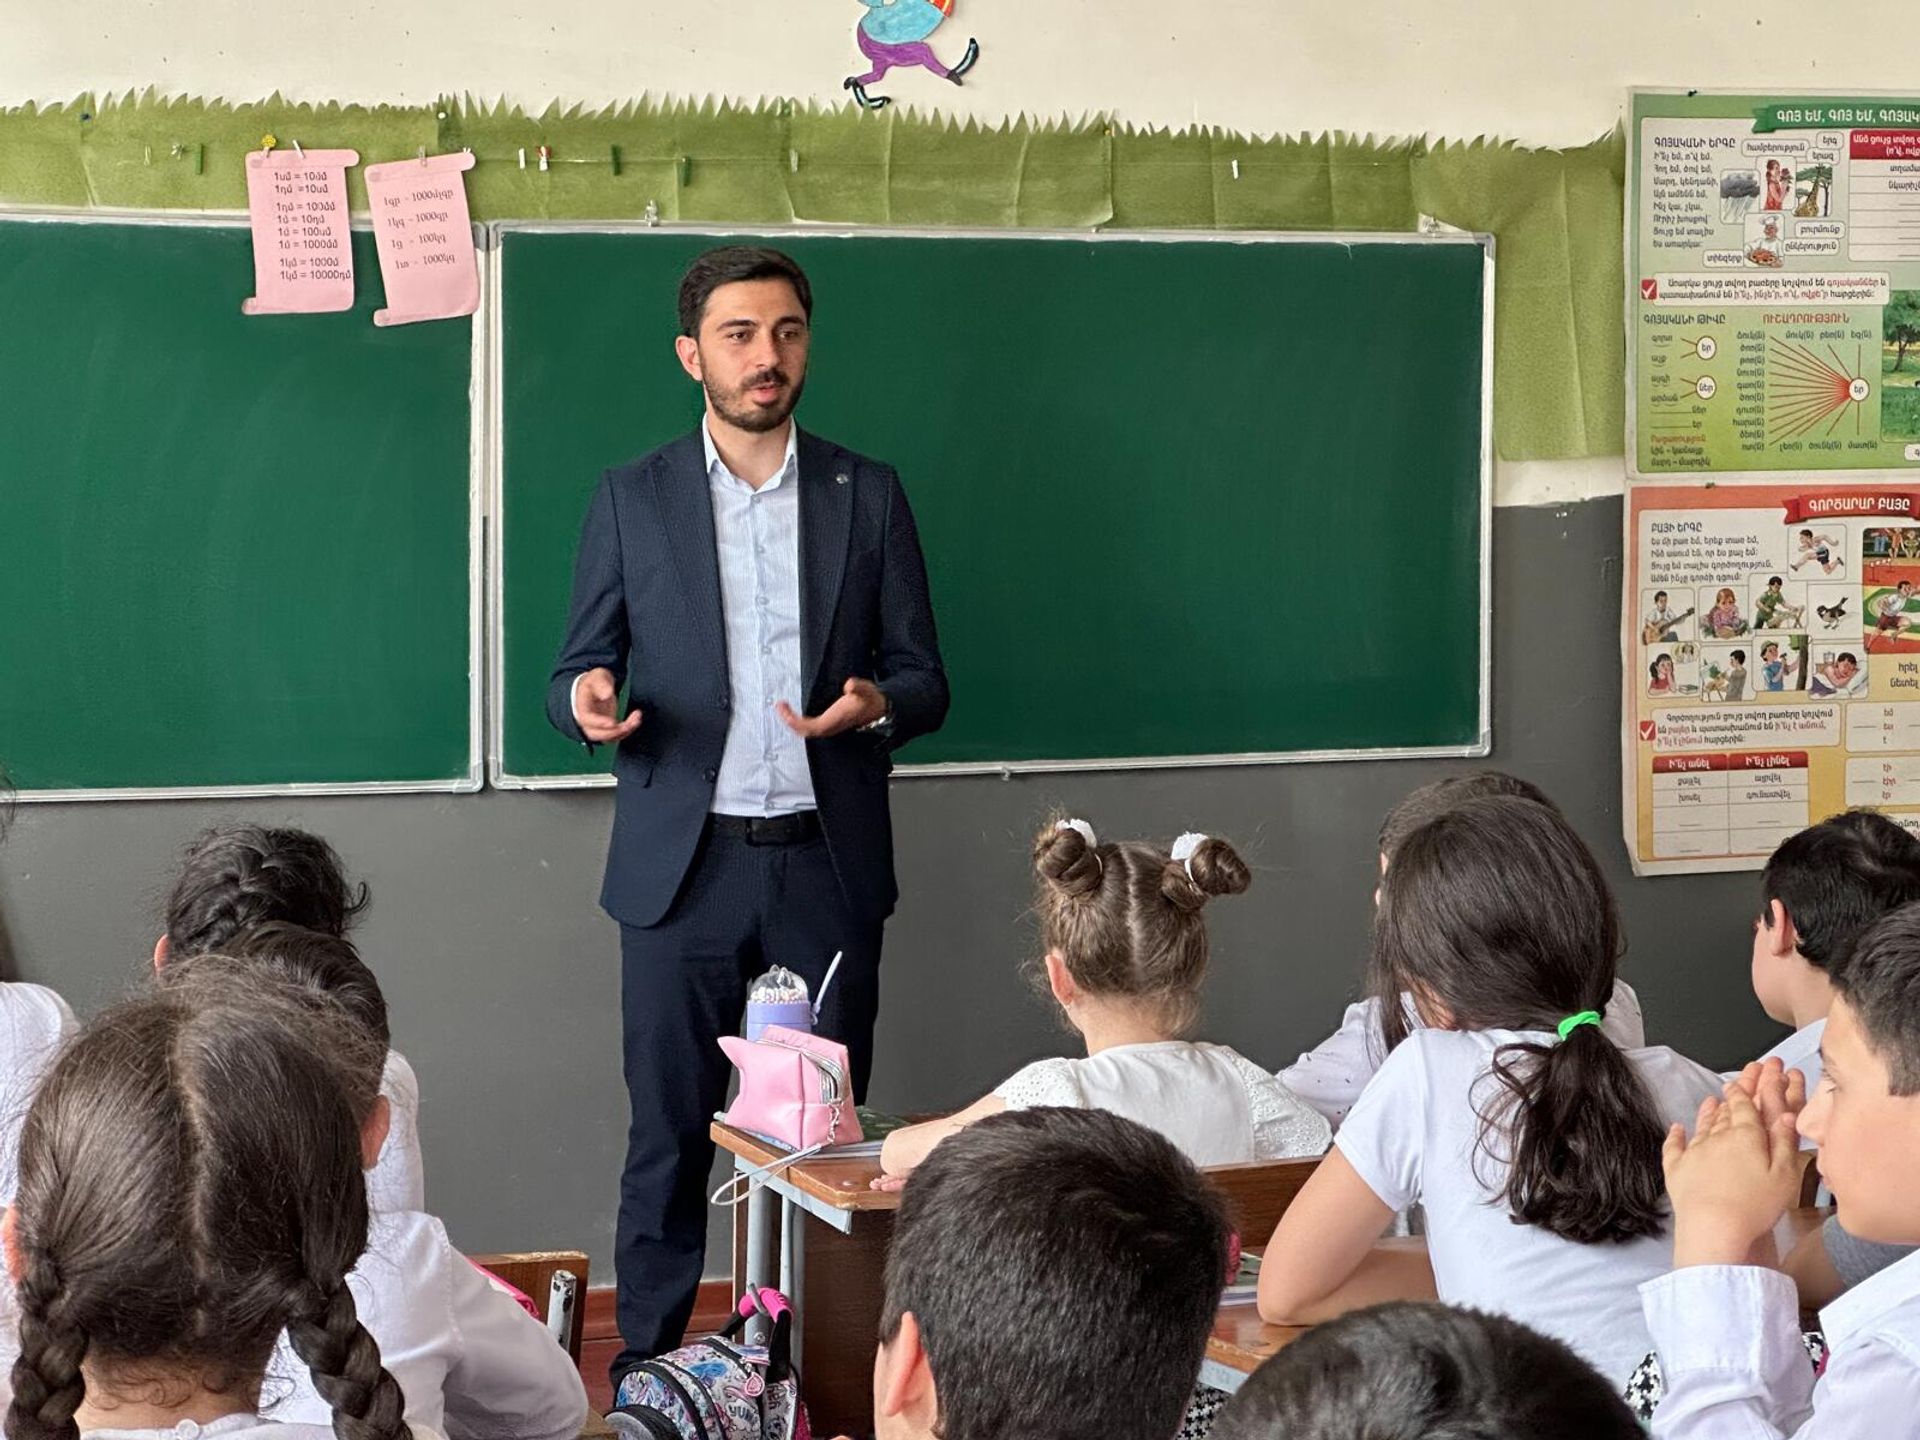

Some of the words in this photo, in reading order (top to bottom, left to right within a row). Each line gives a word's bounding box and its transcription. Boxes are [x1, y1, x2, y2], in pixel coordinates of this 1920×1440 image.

[1777, 110, 1800, 122] ԳՈՅ
[1805, 110, 1825, 122] ԵՄ,
[1829, 110, 1853, 121] ԳՈՅ
[1856, 110, 1876, 122] ԵՄ,
[1654, 137, 1706, 148] ԳՈՅԱԿԱՆԻ
[1709, 137, 1736, 148] ԵՐԳԸ
[274, 171, 291, 181] 1սմ
[275, 184, 293, 195] 1դմ
[276, 202, 294, 213] 1դմ
[278, 215, 289, 224] 1մ
[302, 215, 325, 225] 10դմ
[278, 227, 290, 236] 1մ
[279, 240, 291, 249] 1մ
[304, 239, 338, 249] 1000մմ
[280, 258, 297, 268] 1կմ
[310, 257, 339, 266] 1000մ
[280, 271, 298, 282] 1կմ
[1644, 314, 1694, 324] ԳՈՅԱԿԱՆԻ
[1697, 314, 1726, 325] ԹԻՎԸ
[1809, 497, 1875, 512] ԳՈՐԾԱՐԱՐ
[1878, 497, 1911, 510] ԲԱՅԸ
[1651, 522, 1675, 533] ԲԱՅԻ
[1678, 522, 1702, 532] ԵՐԳԸ
